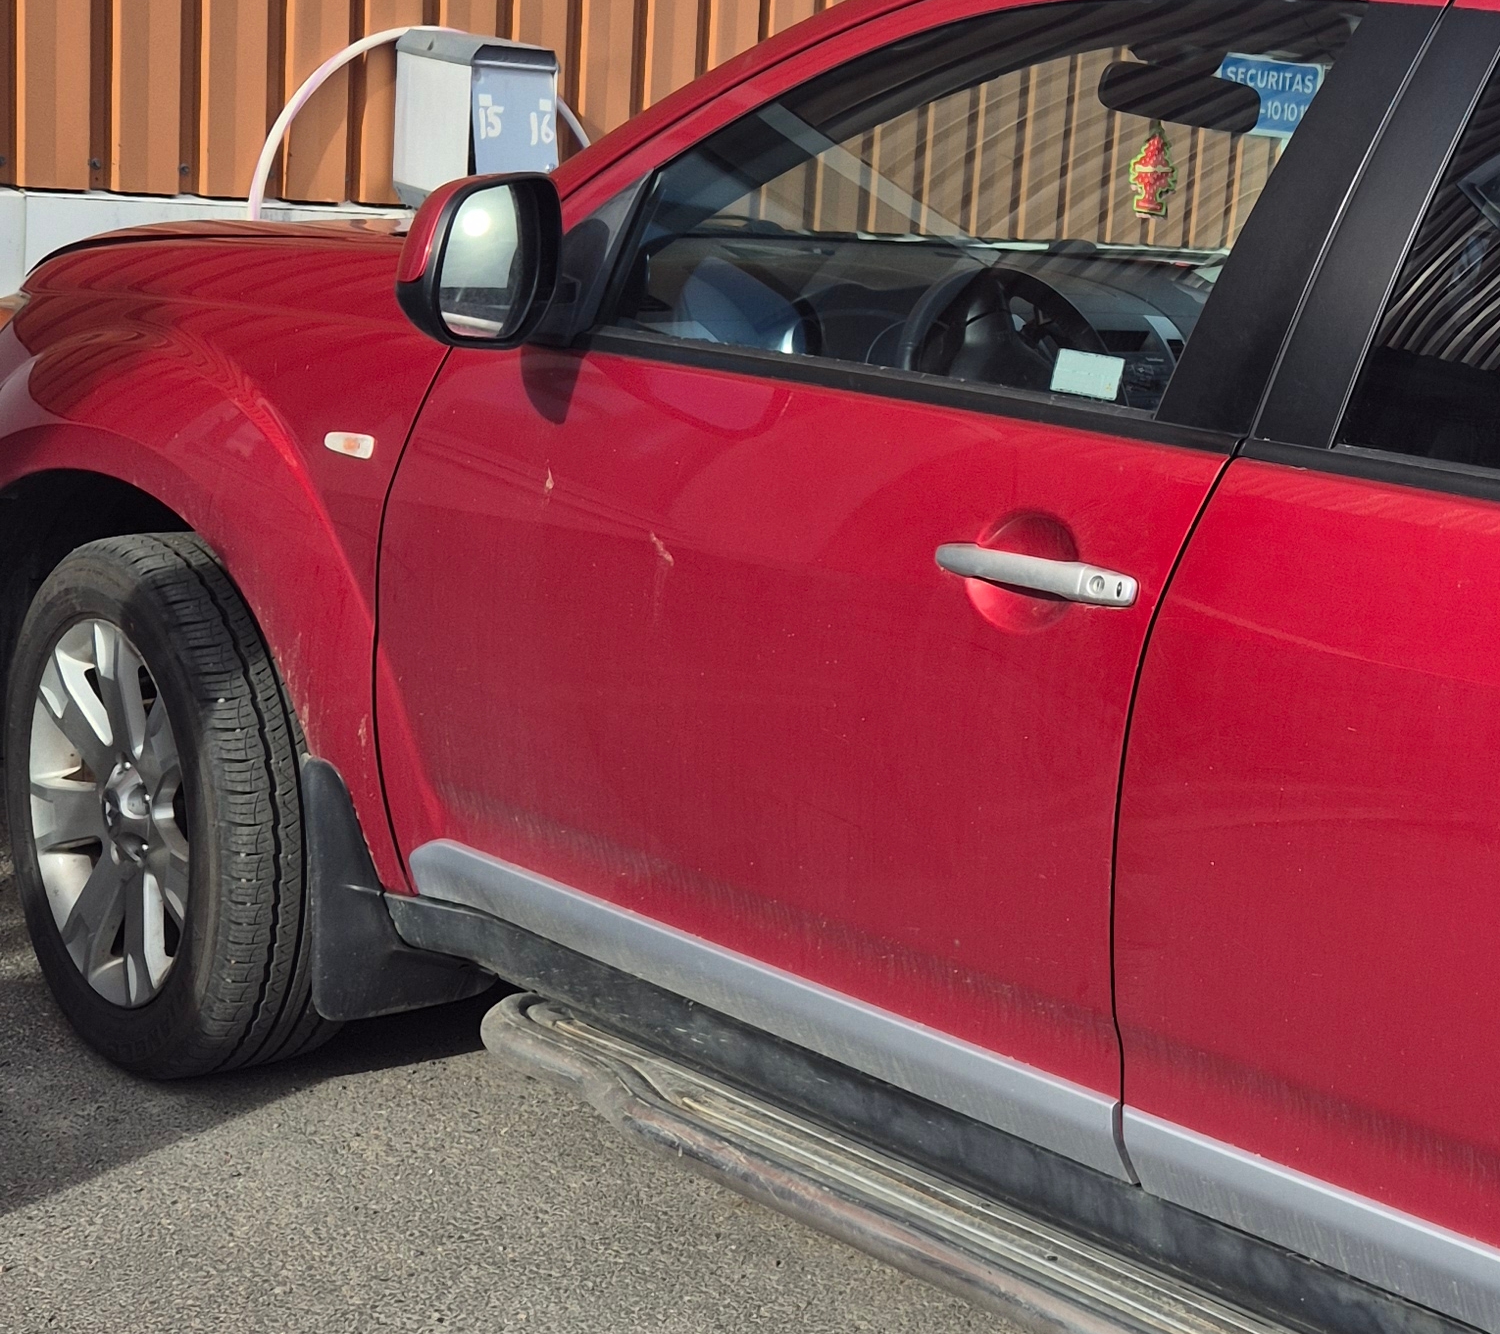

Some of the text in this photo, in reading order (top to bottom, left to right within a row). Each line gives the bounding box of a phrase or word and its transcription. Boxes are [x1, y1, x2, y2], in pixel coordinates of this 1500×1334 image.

[1226, 67, 1315, 94] SECURITAS
[479, 105, 555, 146] 15 16
